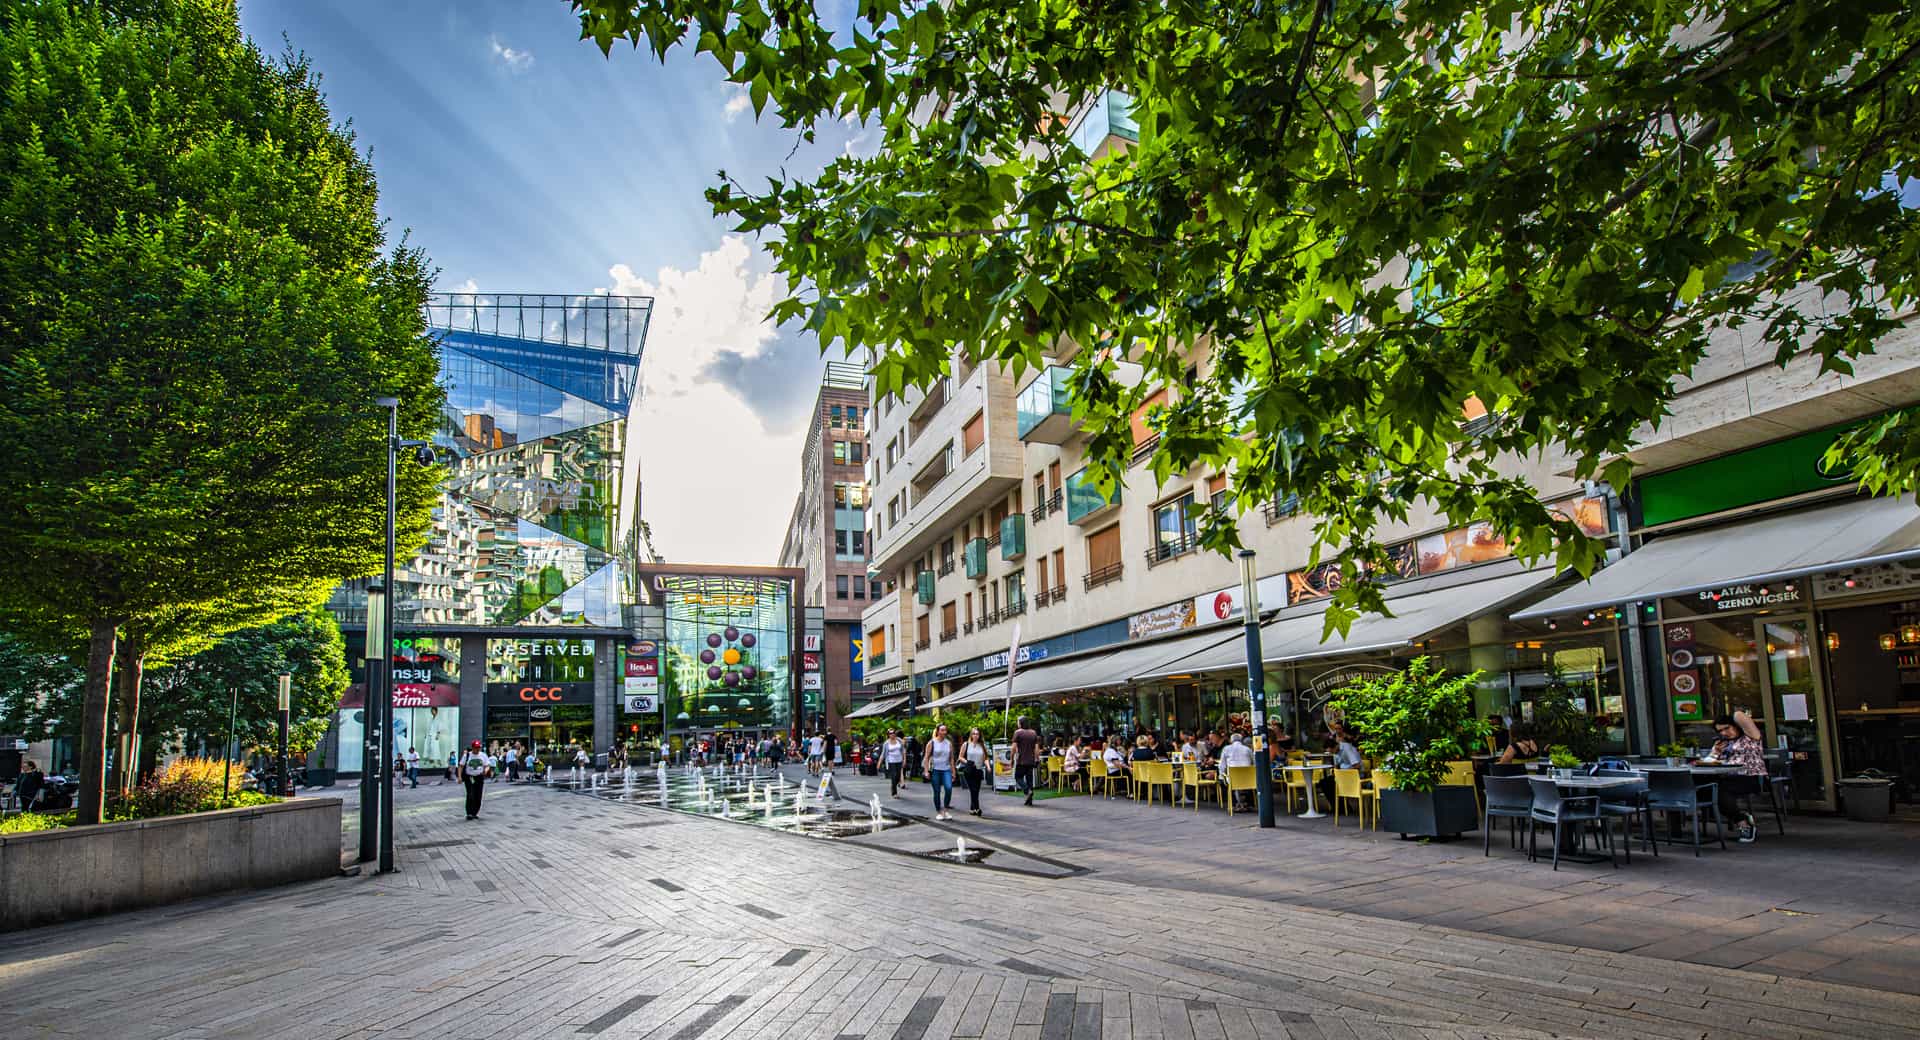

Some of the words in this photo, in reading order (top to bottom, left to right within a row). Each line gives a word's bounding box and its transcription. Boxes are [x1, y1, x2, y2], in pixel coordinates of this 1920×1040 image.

[1699, 584, 1752, 600] SAATAK
[1717, 590, 1800, 609] SZENDVICSEK
[492, 645, 593, 656] RESERVED
[392, 668, 432, 683] nsay
[519, 687, 563, 702] CCC
